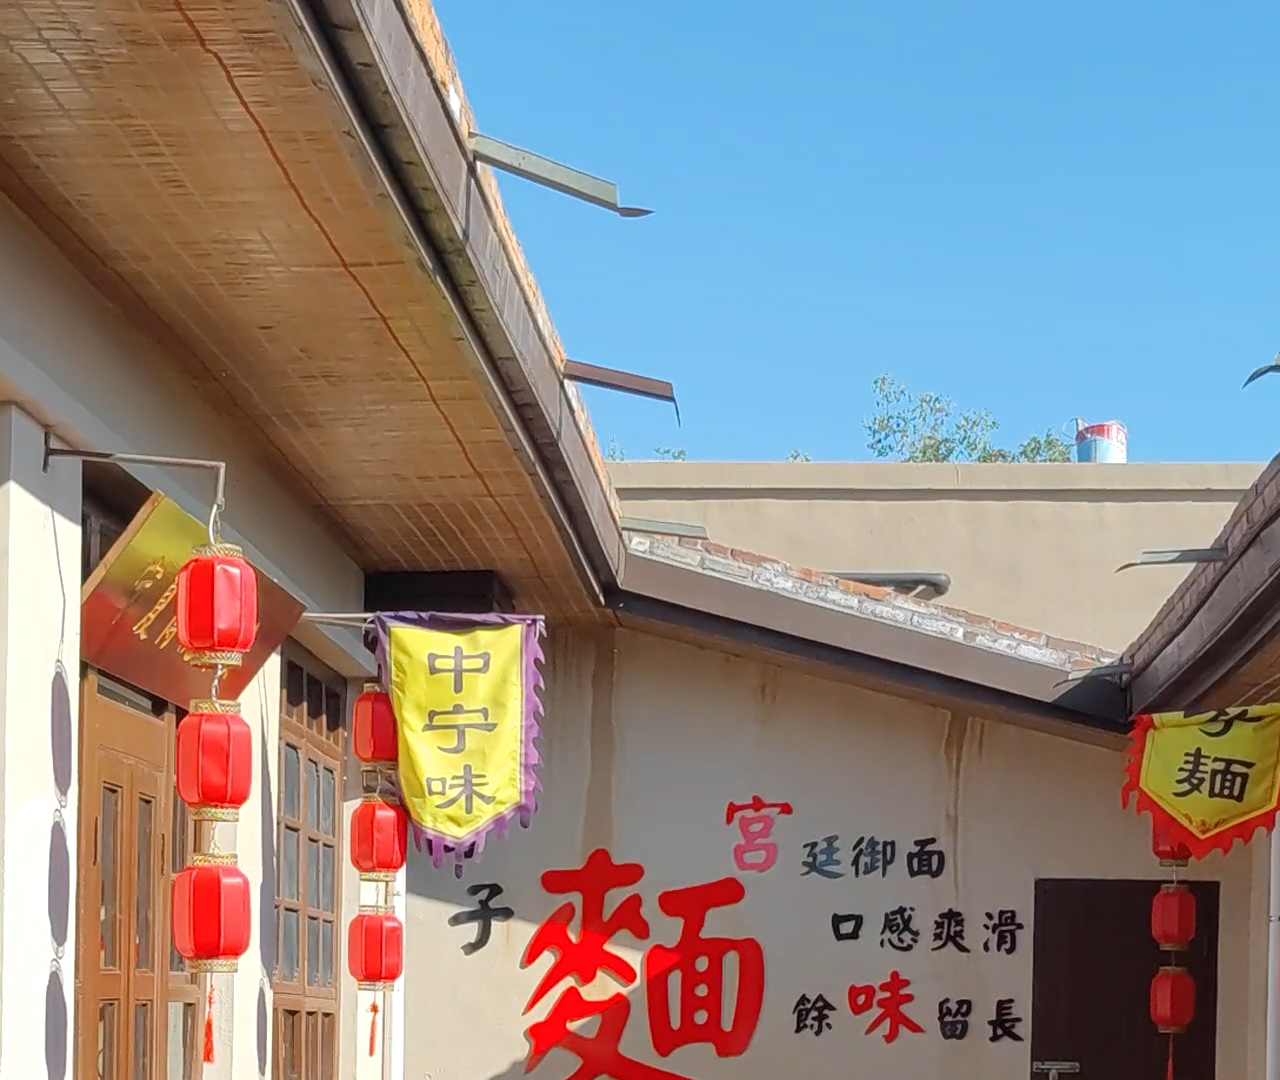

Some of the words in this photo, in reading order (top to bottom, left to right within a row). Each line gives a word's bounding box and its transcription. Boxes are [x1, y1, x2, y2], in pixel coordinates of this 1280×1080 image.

[421, 645, 499, 815] 中宁味
[831, 905, 1024, 955] 口感爽滑
